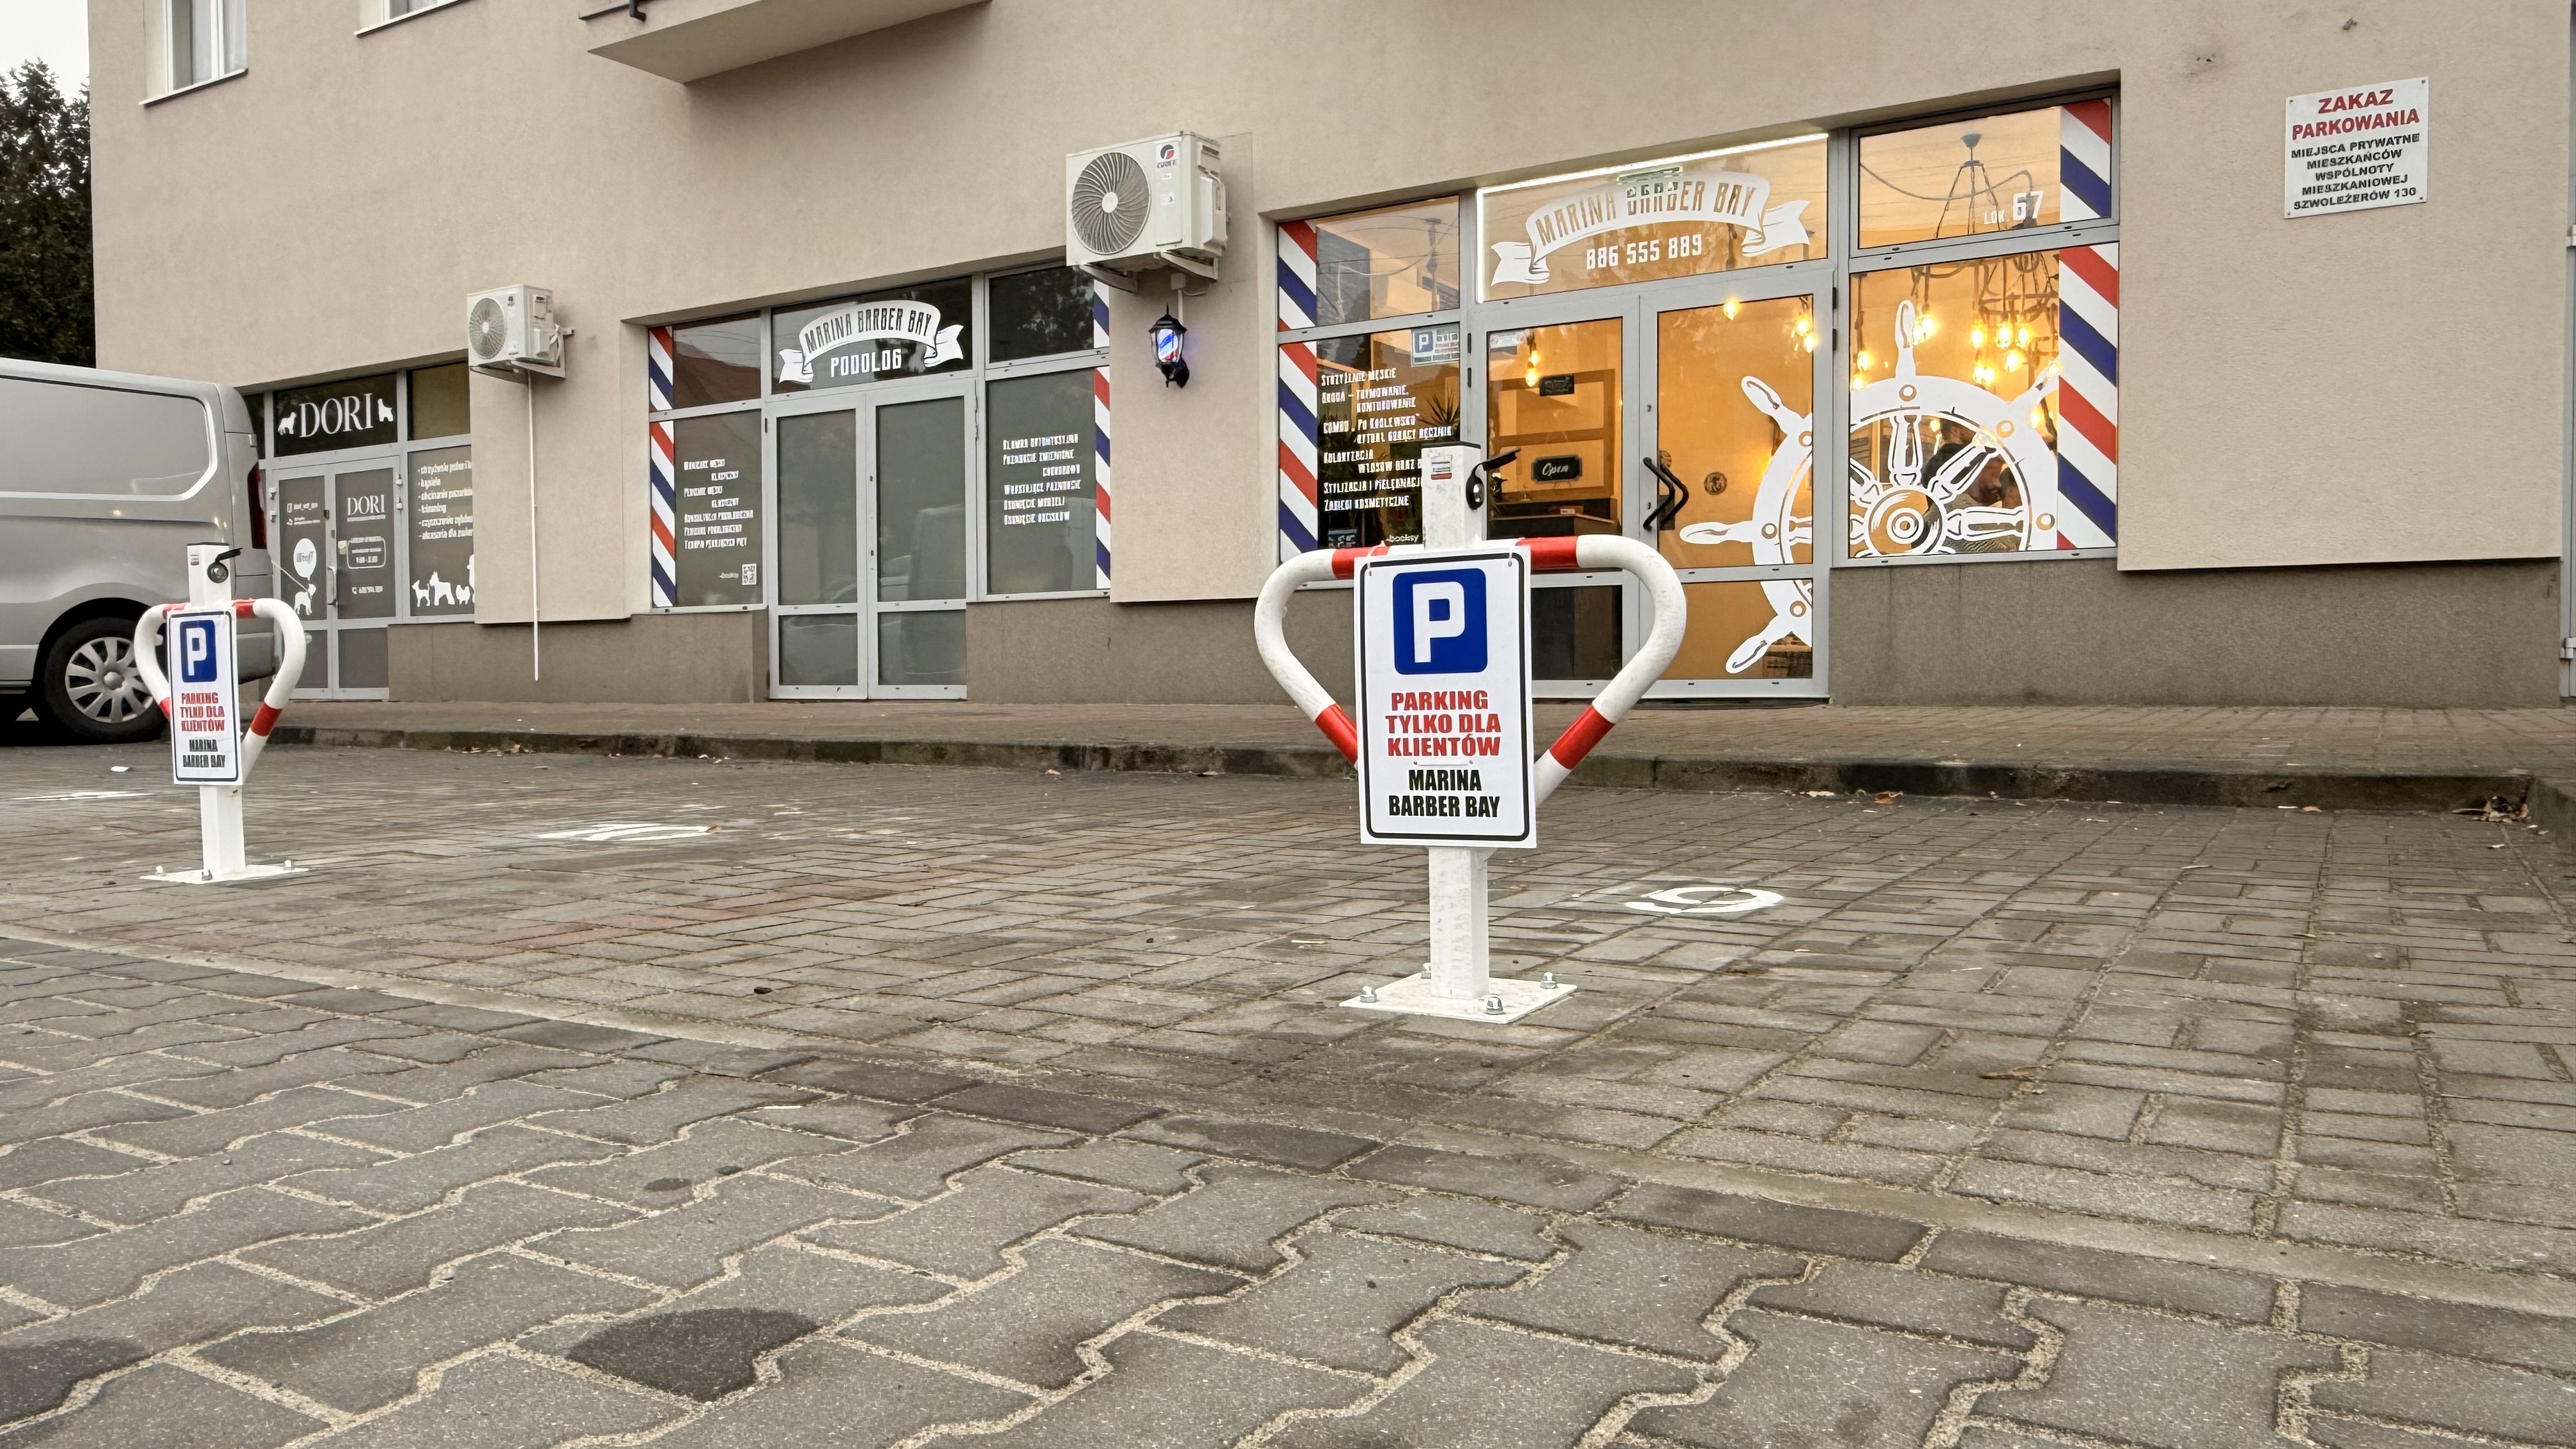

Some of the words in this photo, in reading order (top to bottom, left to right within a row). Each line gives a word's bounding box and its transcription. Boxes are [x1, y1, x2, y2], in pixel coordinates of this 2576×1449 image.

[2318, 89, 2393, 114] ZAKAZ
[2292, 108, 2419, 140] PARKOWANIA
[2292, 144, 2345, 158] MIEJSCA
[2350, 133, 2420, 151] PRYWATNE
[2307, 149, 2402, 169] MIESZKAŃCÓW
[2315, 163, 2394, 181] WSPÓLNOTY
[2303, 174, 2408, 195] MIESZKANIOWEJ
[2013, 191, 2044, 222] 67
[2294, 190, 2389, 210] SZWOLEŻERÓW
[2394, 187, 2416, 198] 130
[1535, 192, 1617, 247] MARINA
[1627, 181, 1705, 215] BARBER
[1713, 182, 1756, 216] BAY
[1586, 245, 1618, 270] 886
[1626, 240, 1660, 264] 555
[1667, 234, 1703, 258] 889
[805, 314, 852, 353] MARINA
[858, 308, 903, 333] BARBER
[908, 310, 931, 336] BAY
[831, 349, 901, 377] PODOLOG
[299, 393, 373, 438] DORI
[1542, 463, 1568, 476] Open
[348, 494, 385, 516] DORI
[1413, 581, 1465, 663] P
[186, 627, 207, 676] P
[181, 693, 218, 704] PARKING
[1392, 690, 1488, 711] PARKING
[180, 706, 203, 717] TYLKO
[206, 706, 225, 717] DLA
[181, 719, 225, 732] KLIENTÓW
[1385, 714, 1452, 734] TYLKO
[1459, 714, 1501, 733] DLA
[189, 739, 218, 752] MARINA
[1388, 733, 1500, 756] KLIENTÓW
[1409, 770, 1481, 792] MARINA
[1389, 795, 1459, 816] BARBER
[1466, 795, 1500, 818] BAY
